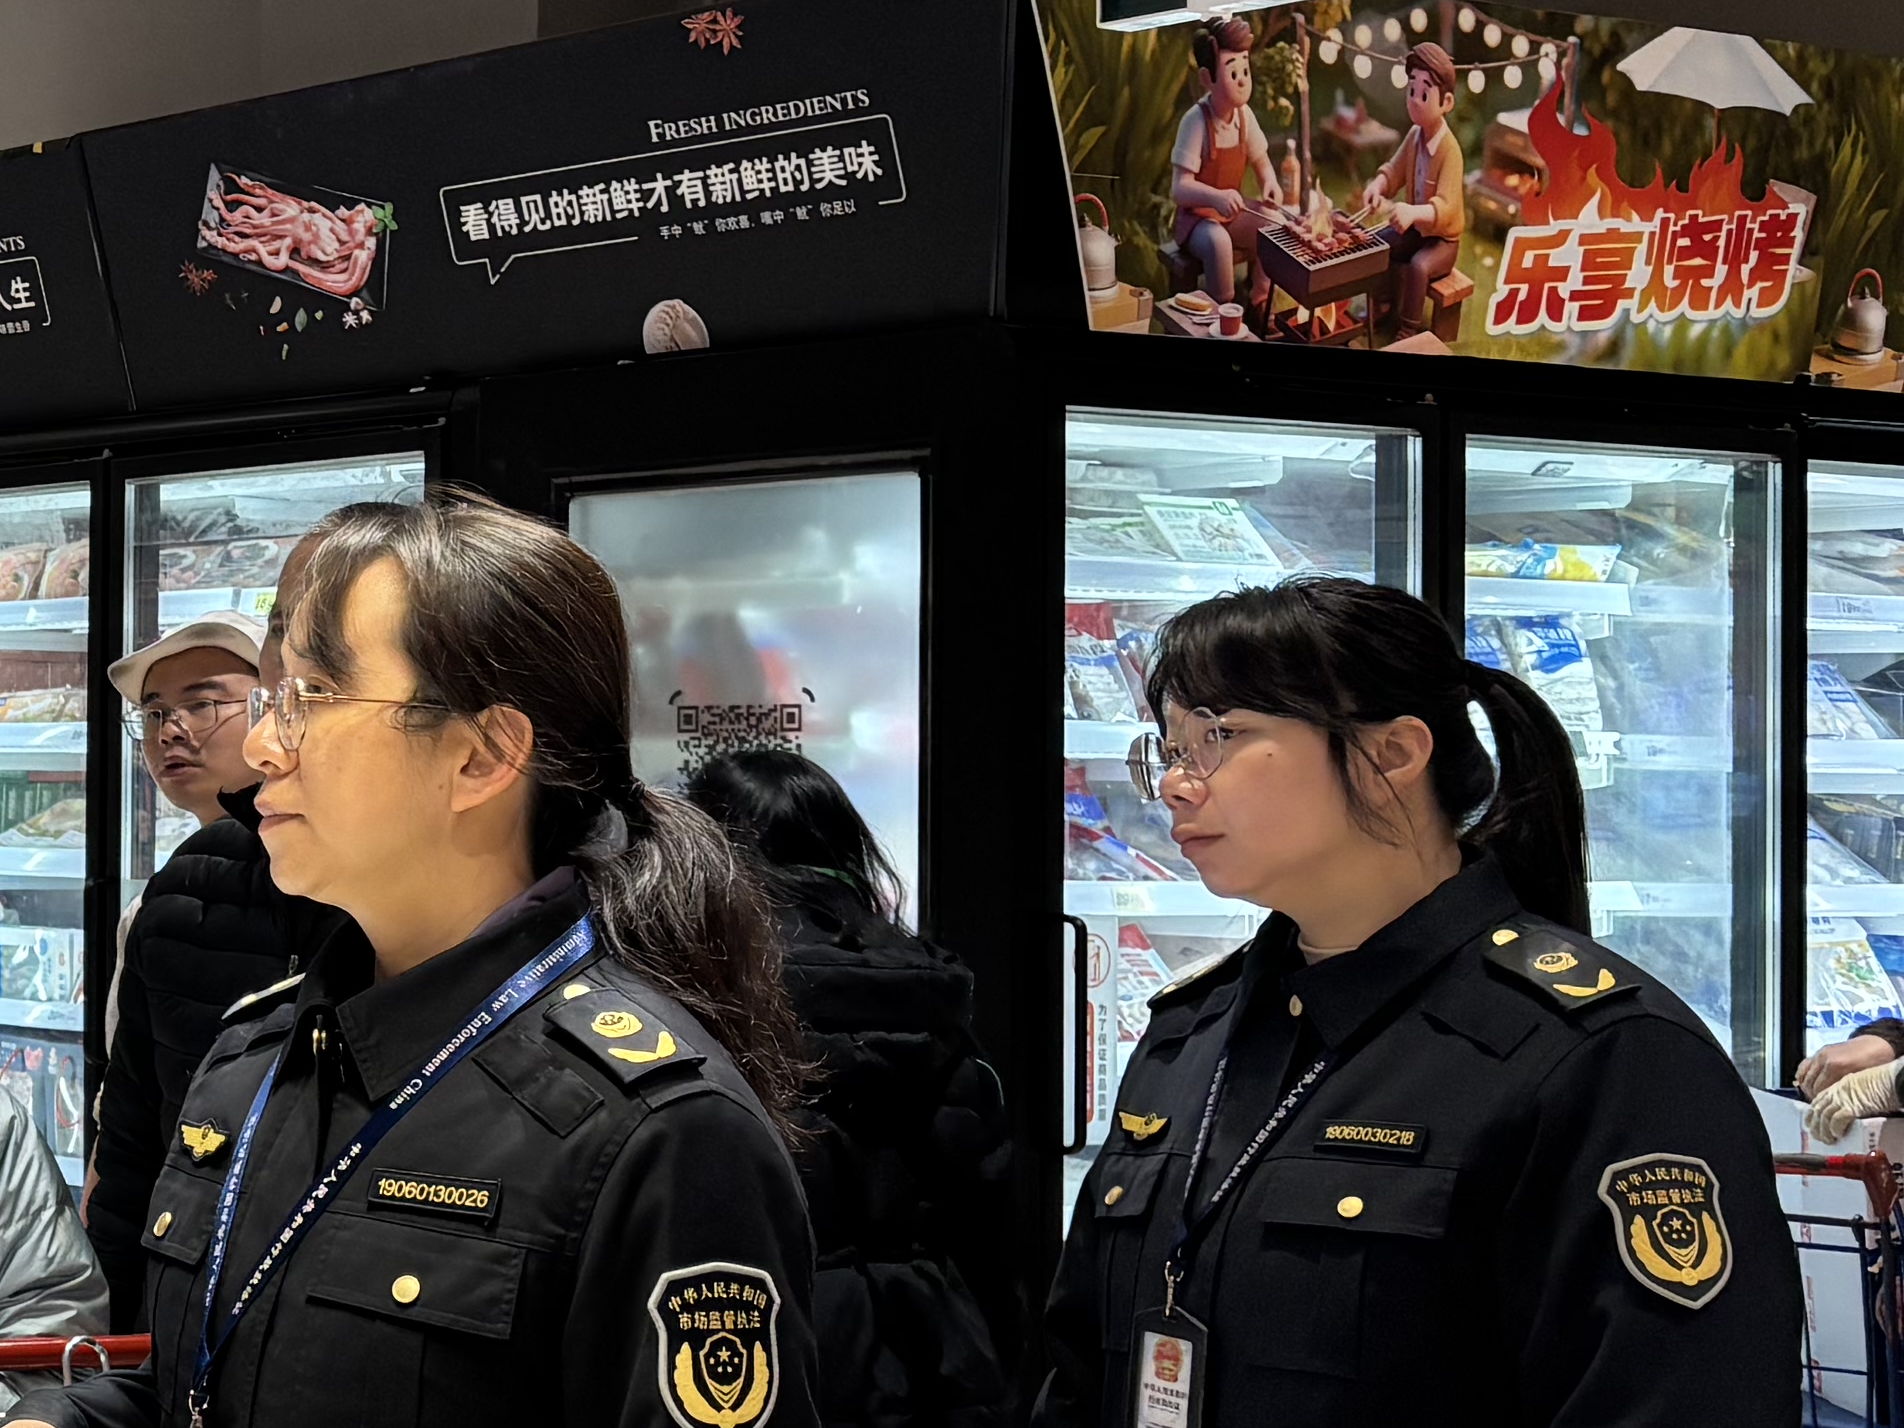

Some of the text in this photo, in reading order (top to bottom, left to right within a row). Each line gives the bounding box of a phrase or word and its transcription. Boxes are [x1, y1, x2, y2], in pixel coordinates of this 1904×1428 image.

[647, 88, 871, 144] FRESH INGREDIENTS
[459, 140, 883, 243] 看得见的新鲜才有新鲜的美味
[1491, 205, 1804, 332] 乐享烧烤
[421, 1011, 493, 1077] Enforcement
[389, 1078, 424, 1110] China
[1324, 1124, 1415, 1147] 19060030218
[377, 1177, 490, 1209] 19060130026
[1615, 1167, 1707, 1193] 中华人民共和国
[668, 1281, 768, 1312] 中华人民共和国
[678, 1310, 761, 1330] 市场监管执法
